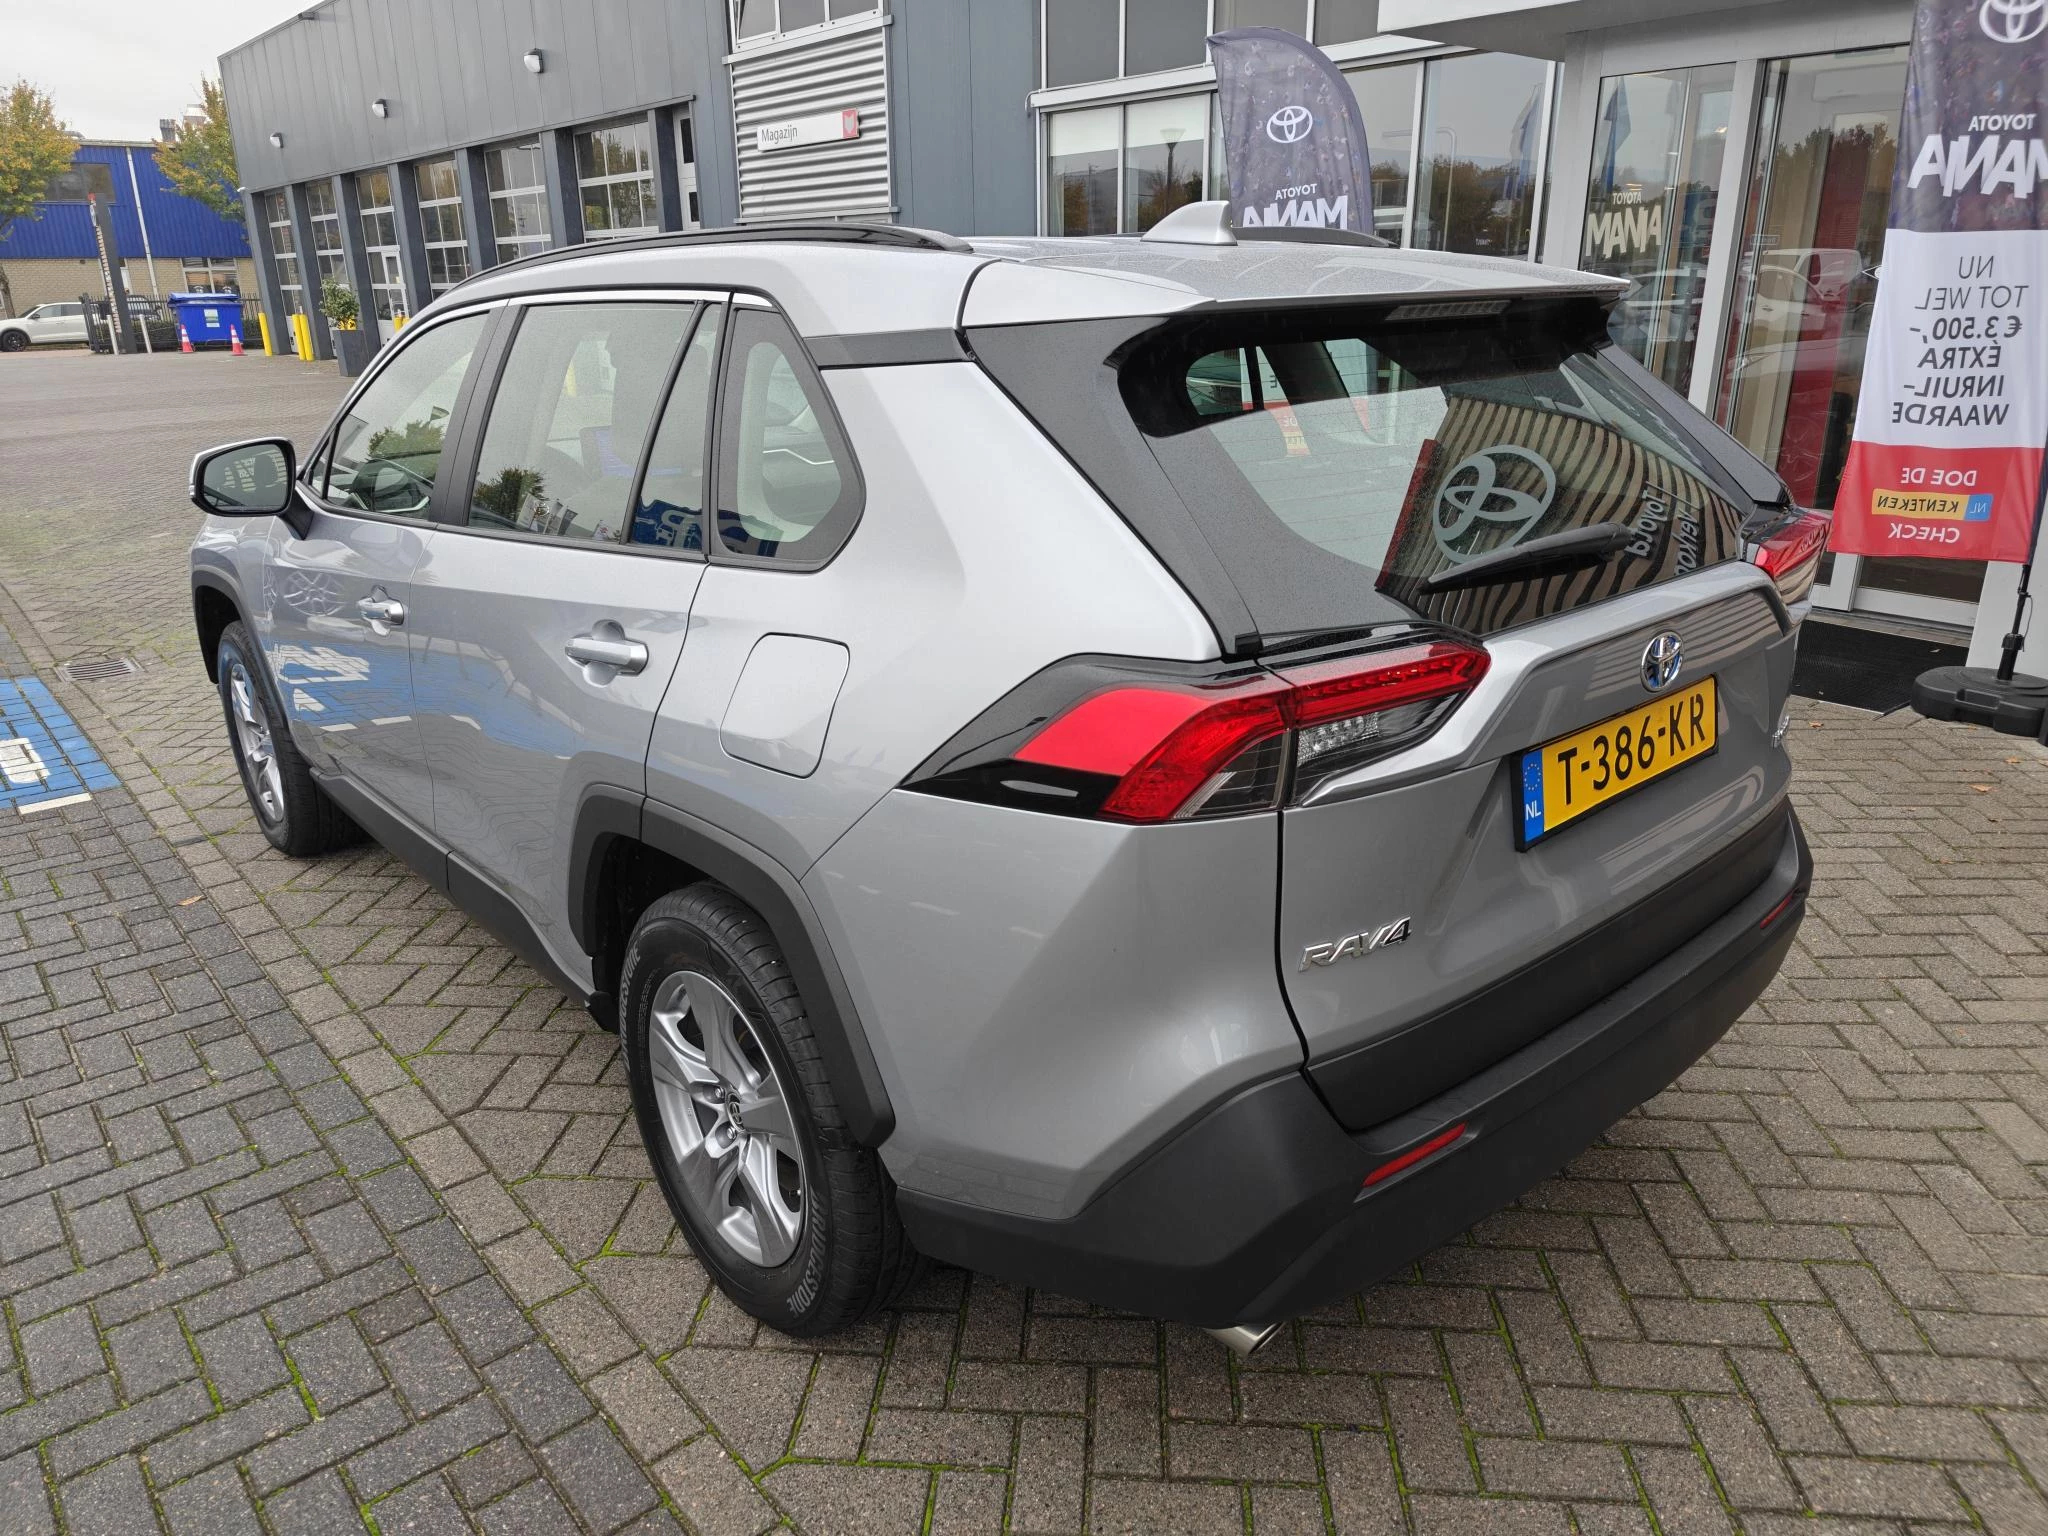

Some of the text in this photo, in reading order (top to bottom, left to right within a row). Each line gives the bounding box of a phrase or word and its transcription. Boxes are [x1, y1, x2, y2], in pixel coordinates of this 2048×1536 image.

[761, 125, 798, 144] Magazijn
[1612, 191, 1642, 205] TOYOTA
[1585, 204, 1662, 259] MANIA
[1525, 800, 1542, 821] NL
[1557, 692, 1706, 806] T-386-KR
[1298, 916, 1412, 972] RAV4
